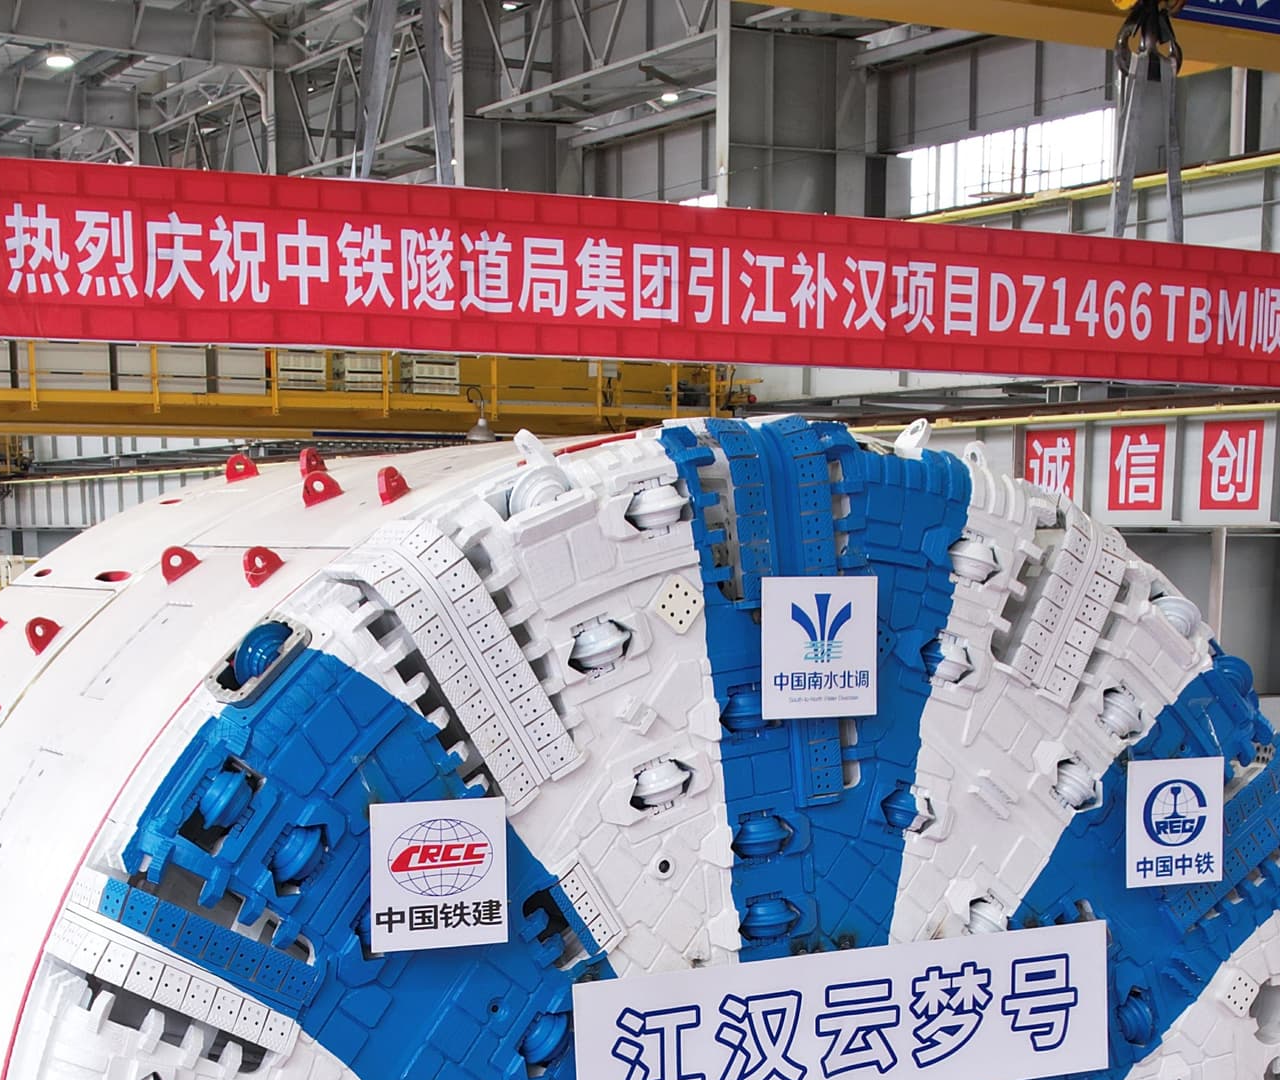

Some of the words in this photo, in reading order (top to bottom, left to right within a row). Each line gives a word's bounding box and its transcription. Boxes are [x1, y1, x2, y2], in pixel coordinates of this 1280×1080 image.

[773, 670, 869, 691] 中国南水北调
[391, 842, 489, 872] CRCC
[1136, 851, 1215, 879] 中国中铁
[375, 899, 503, 933] 中国铁建
